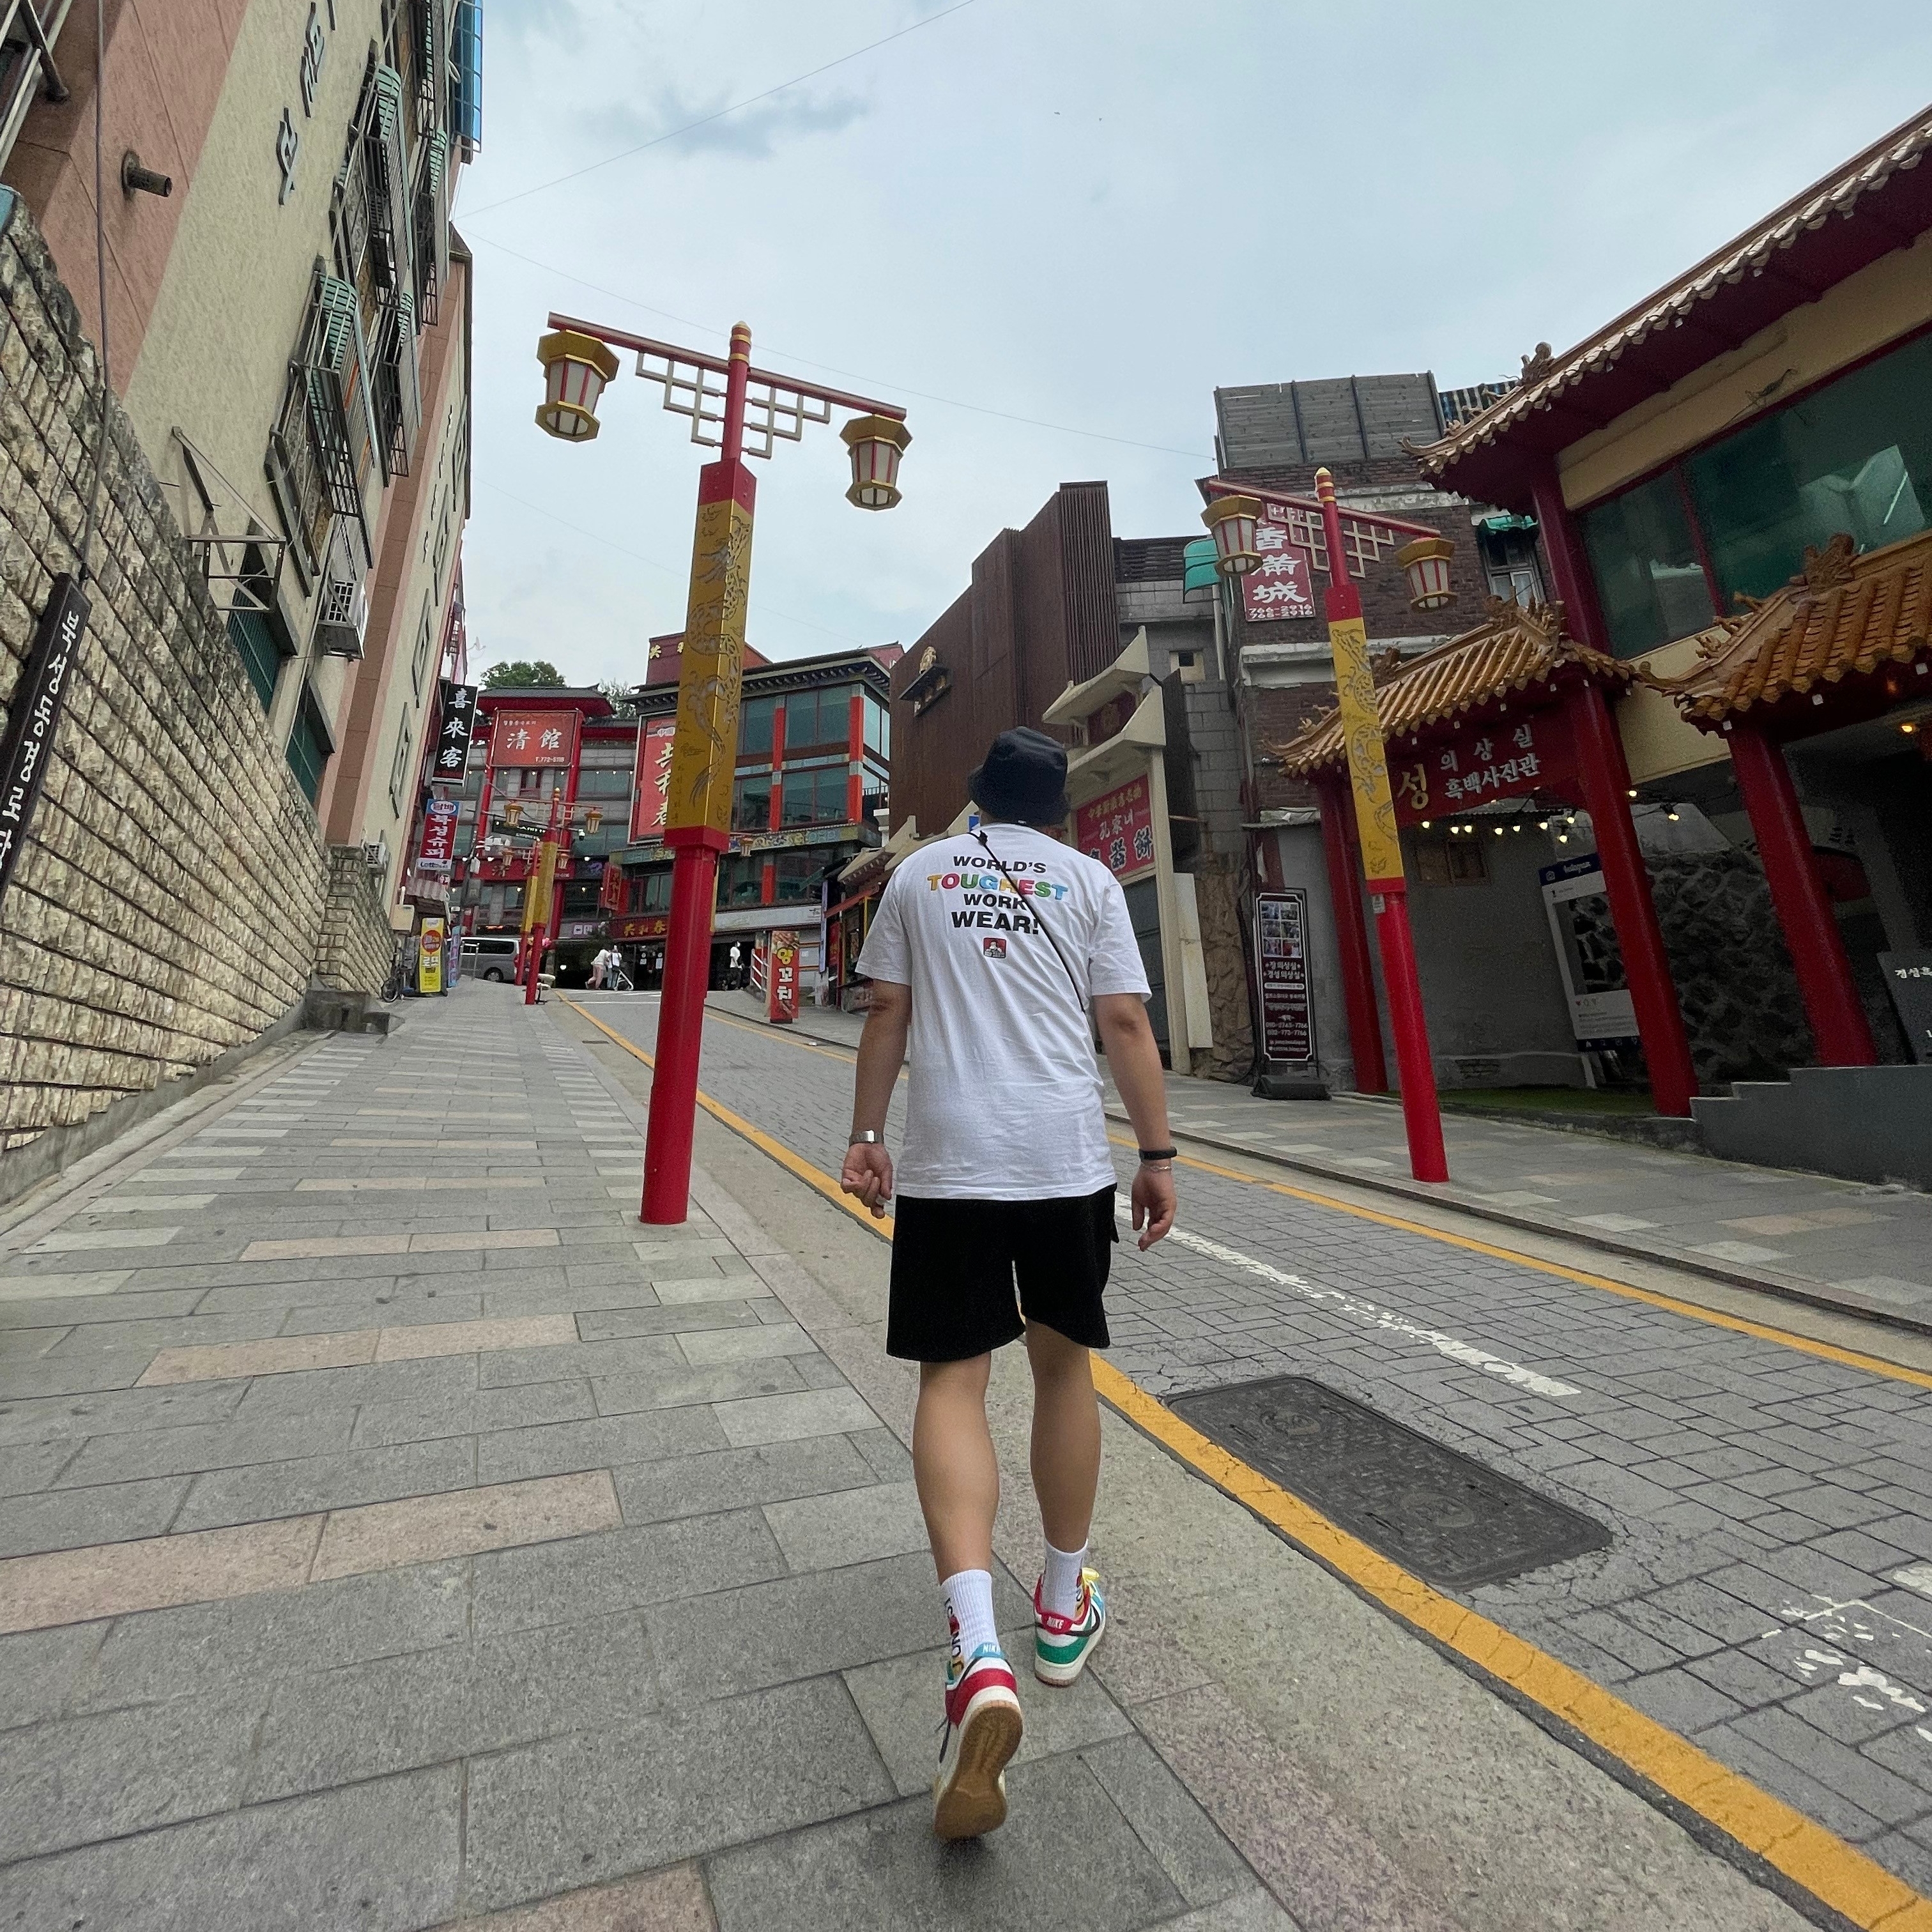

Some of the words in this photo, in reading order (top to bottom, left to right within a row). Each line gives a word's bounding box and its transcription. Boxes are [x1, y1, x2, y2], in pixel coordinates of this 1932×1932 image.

[275, 0, 337, 206] 빌라
[440, 687, 471, 768] 喜來客
[1445, 753, 1541, 799] 흑백사진관
[431, 802, 455, 814] 담배
[425, 814, 452, 859] 북성슈퍼
[953, 855, 1046, 873] WORLD'S
[927, 873, 1068, 900] TOUGHEST
[964, 894, 1027, 910] WORK
[951, 911, 1039, 935] WEAR!
[777, 948, 793, 1000] 양꼬치
[1046, 1616, 1064, 1629] NIKE
